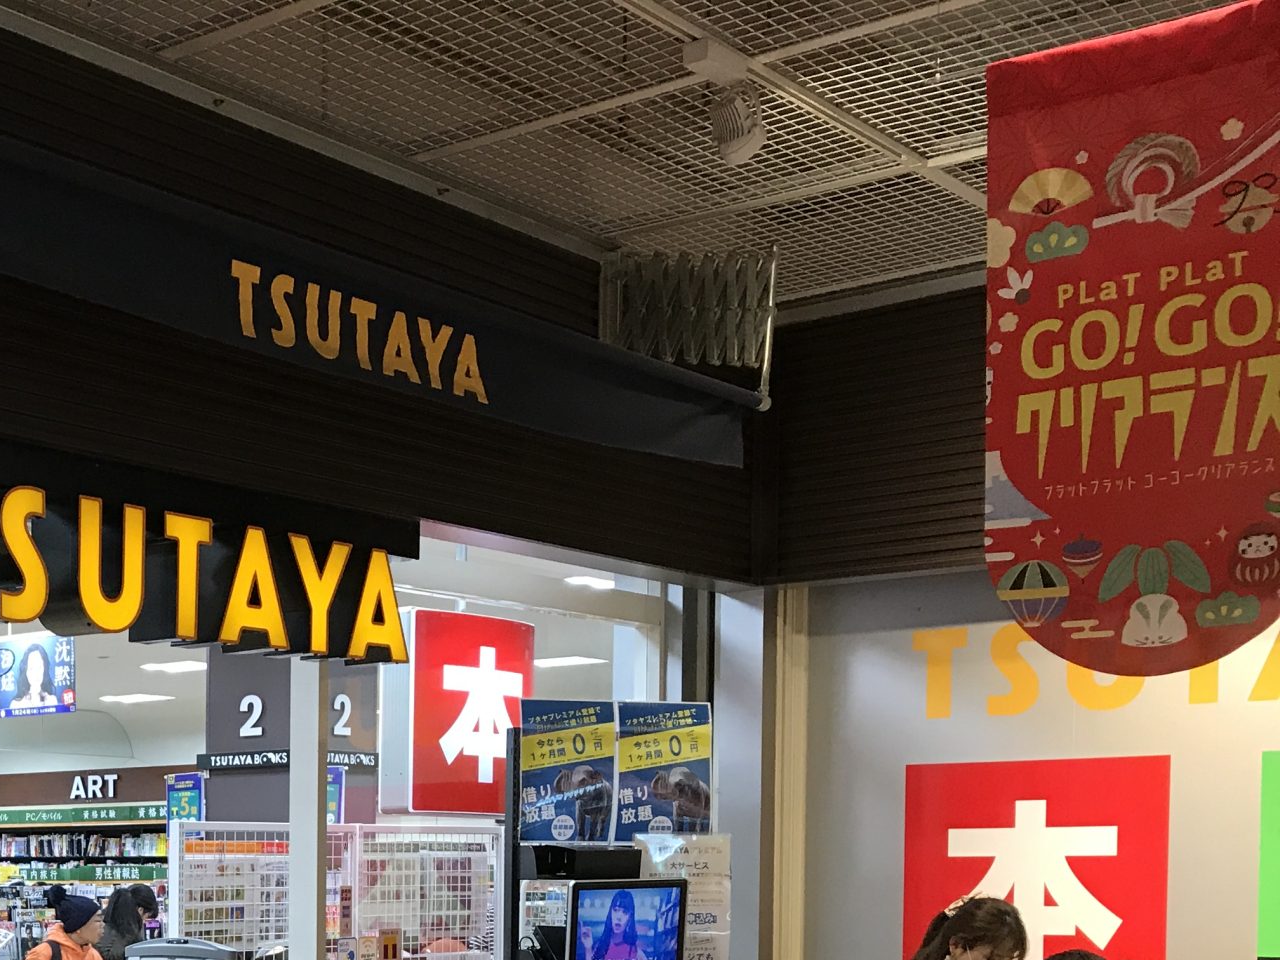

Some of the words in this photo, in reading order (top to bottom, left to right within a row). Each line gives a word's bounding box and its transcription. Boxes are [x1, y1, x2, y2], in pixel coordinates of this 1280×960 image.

[230, 259, 489, 405] TSUTAYA
[1020, 282, 1280, 380] GO!GO
[239, 694, 263, 737] 2
[333, 694, 352, 736] 2
[439, 646, 523, 783] 本
[536, 737, 565, 748] 今なら
[633, 738, 661, 750] 今なら
[210, 755, 253, 766] TSUTAYA
[70, 774, 118, 799] ART
[522, 784, 551, 803] 借り
[619, 785, 648, 805] 借り
[25, 811, 63, 822] PC/モバイル
[137, 806, 167, 818] 資格試
[524, 805, 556, 823] 放題
[620, 806, 653, 824] 放題
[95, 867, 140, 880] 男性情報誌
